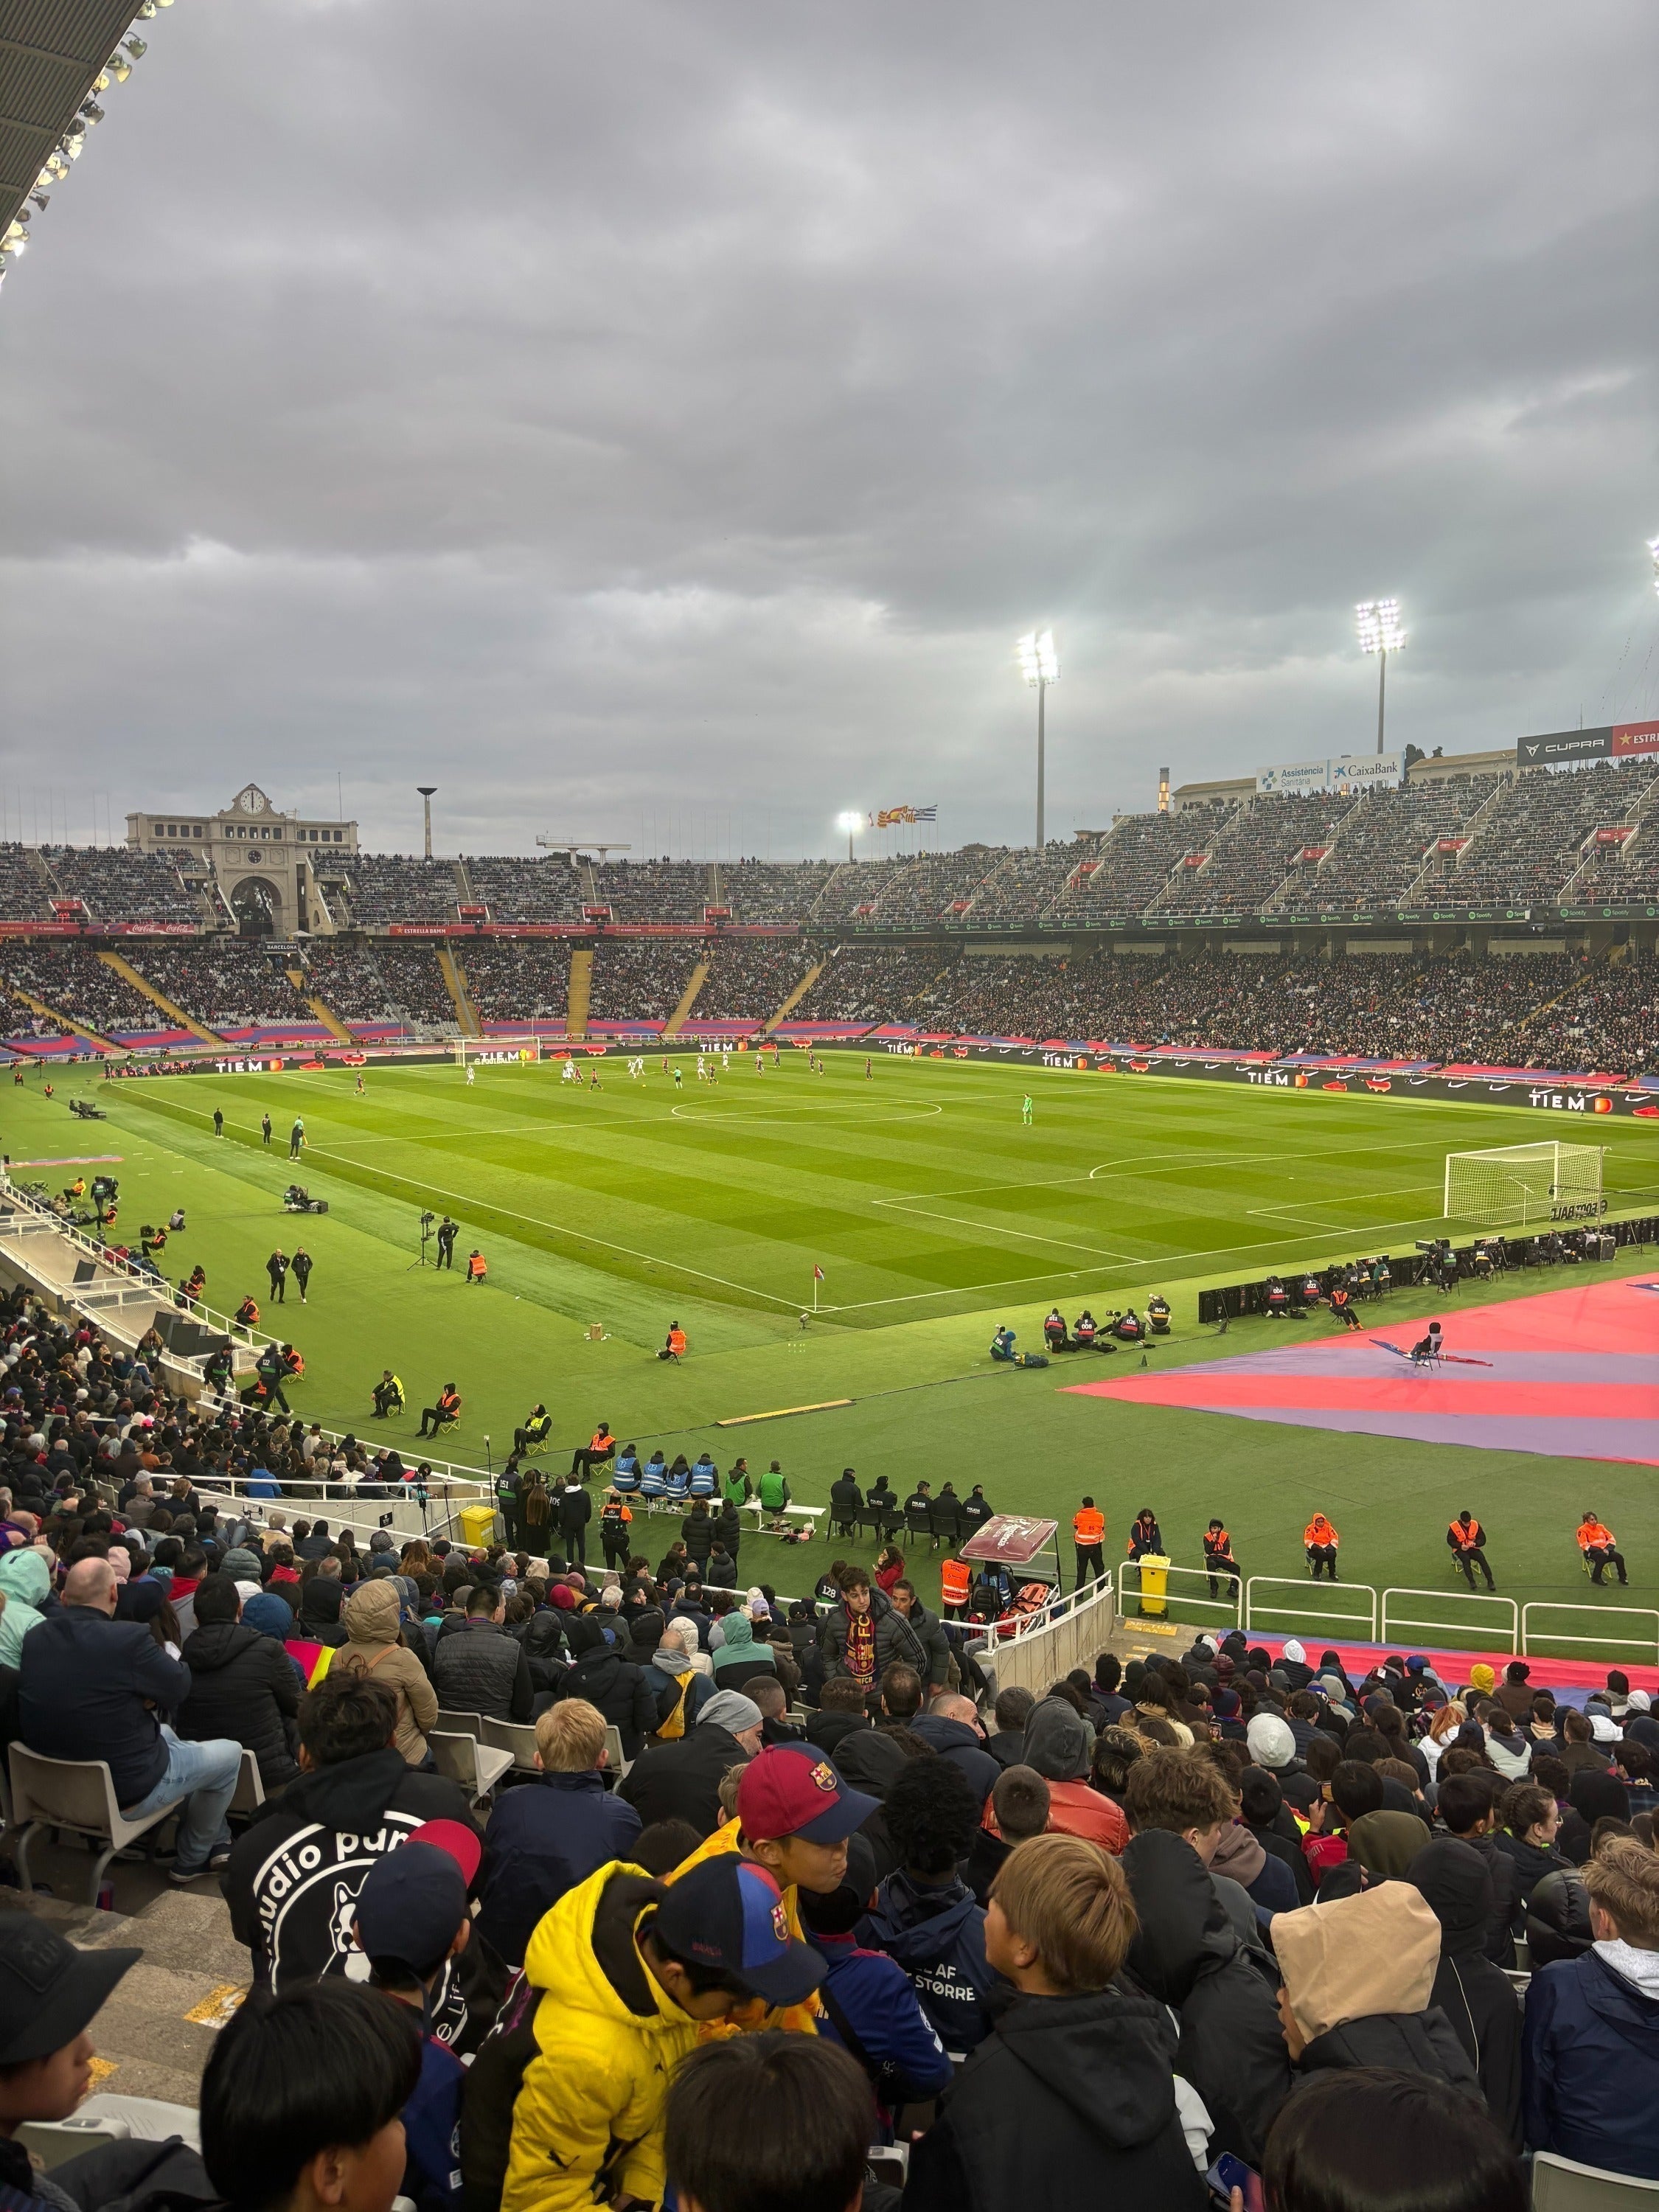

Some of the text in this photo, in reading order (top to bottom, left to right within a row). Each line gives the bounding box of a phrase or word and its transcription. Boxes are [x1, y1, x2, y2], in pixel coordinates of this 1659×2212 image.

[1545, 739, 1604, 753] CUPRA
[1281, 765, 1324, 779] Assistència
[1348, 762, 1398, 776] CaixaBank
[1281, 778, 1310, 787] Sanitària
[700, 1043, 733, 1053] TIEM
[887, 1044, 913, 1054] TIEM
[215, 1061, 262, 1074] TIEM
[1042, 1056, 1073, 1068] TIEM
[1248, 1071, 1288, 1086] TIEM
[1528, 1093, 1585, 1110] TIEM
[500, 1479, 509, 1489] 151
[823, 1585, 836, 1599] 128
[858, 1615, 871, 1638] FC
[861, 1677, 872, 1685] FCB
[260, 1845, 321, 1973] udio
[935, 1963, 956, 1979] AF
[448, 1972, 466, 2015] Lif
[914, 1975, 975, 2001] STØRRE
